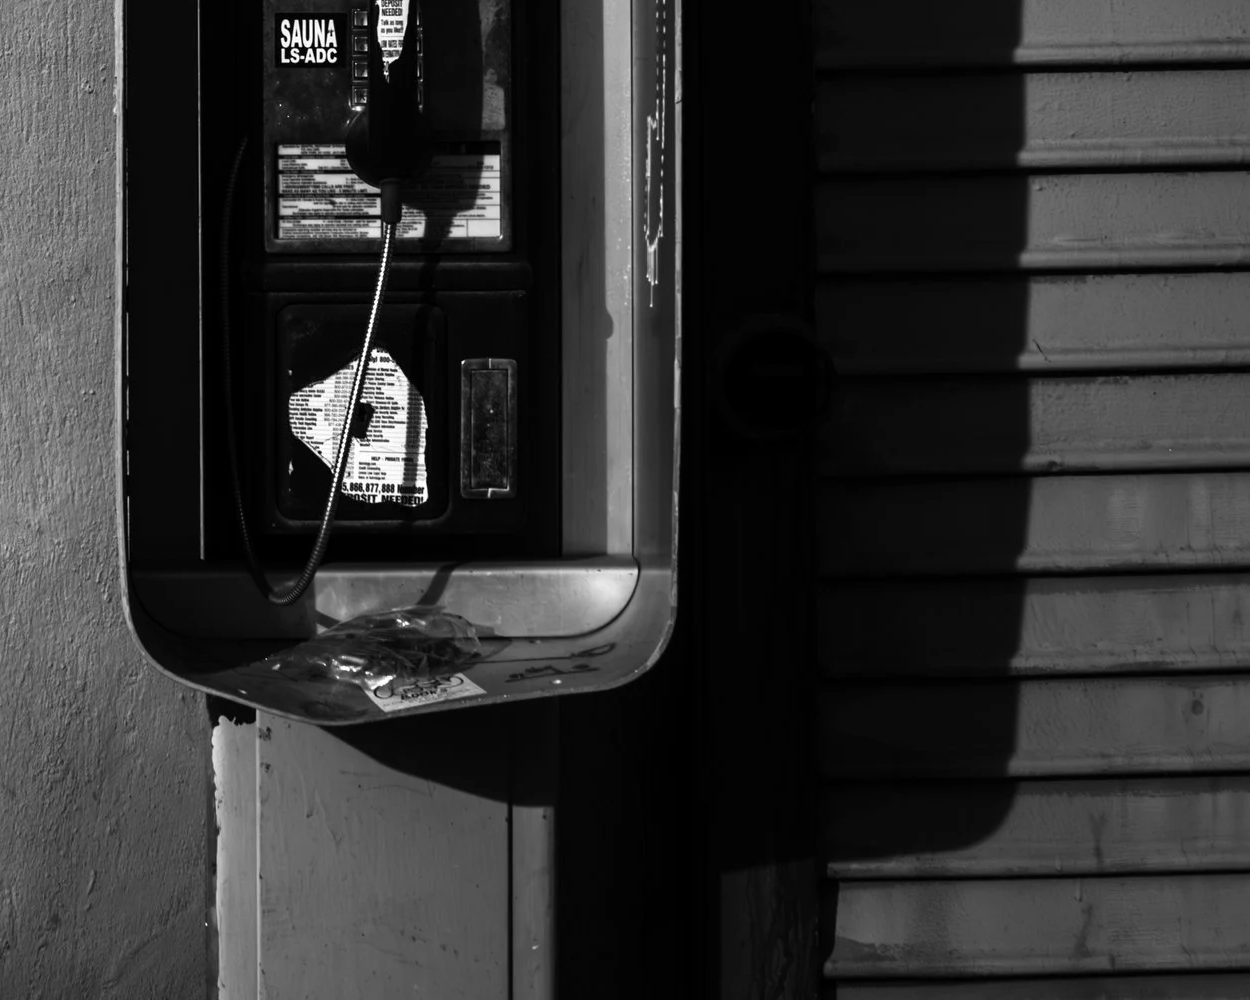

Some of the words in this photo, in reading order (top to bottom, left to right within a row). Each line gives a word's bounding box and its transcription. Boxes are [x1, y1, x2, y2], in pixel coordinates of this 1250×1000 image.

[381, 0, 403, 8] DEPOSIT
[280, 19, 338, 48] SAUNA
[281, 48, 338, 64] LS-ADC
